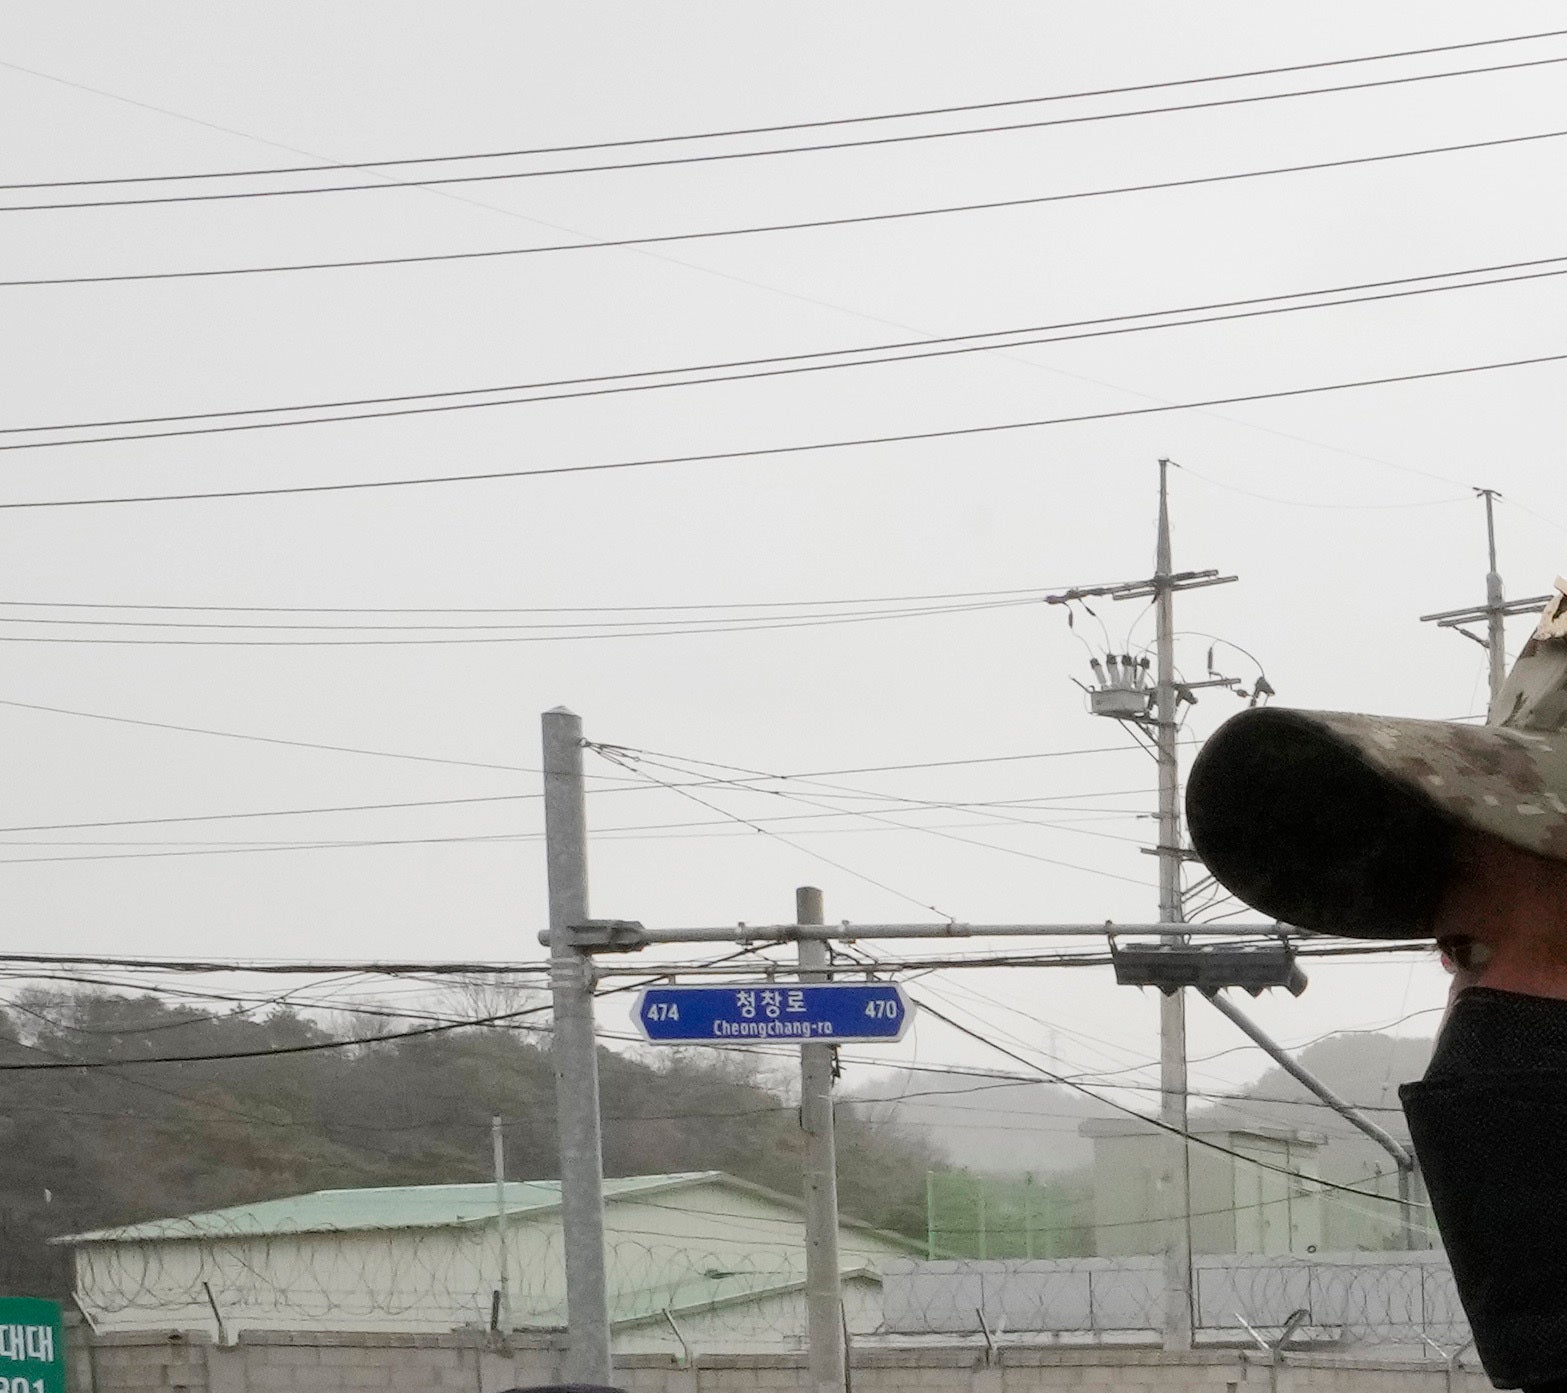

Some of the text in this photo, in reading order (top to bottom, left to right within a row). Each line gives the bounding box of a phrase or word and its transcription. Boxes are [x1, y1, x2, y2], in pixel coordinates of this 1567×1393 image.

[648, 1003, 679, 1021] 474
[737, 990, 807, 1018] 청창로
[866, 1000, 898, 1018] 470
[713, 1019, 833, 1038] Cheongchang-ro
